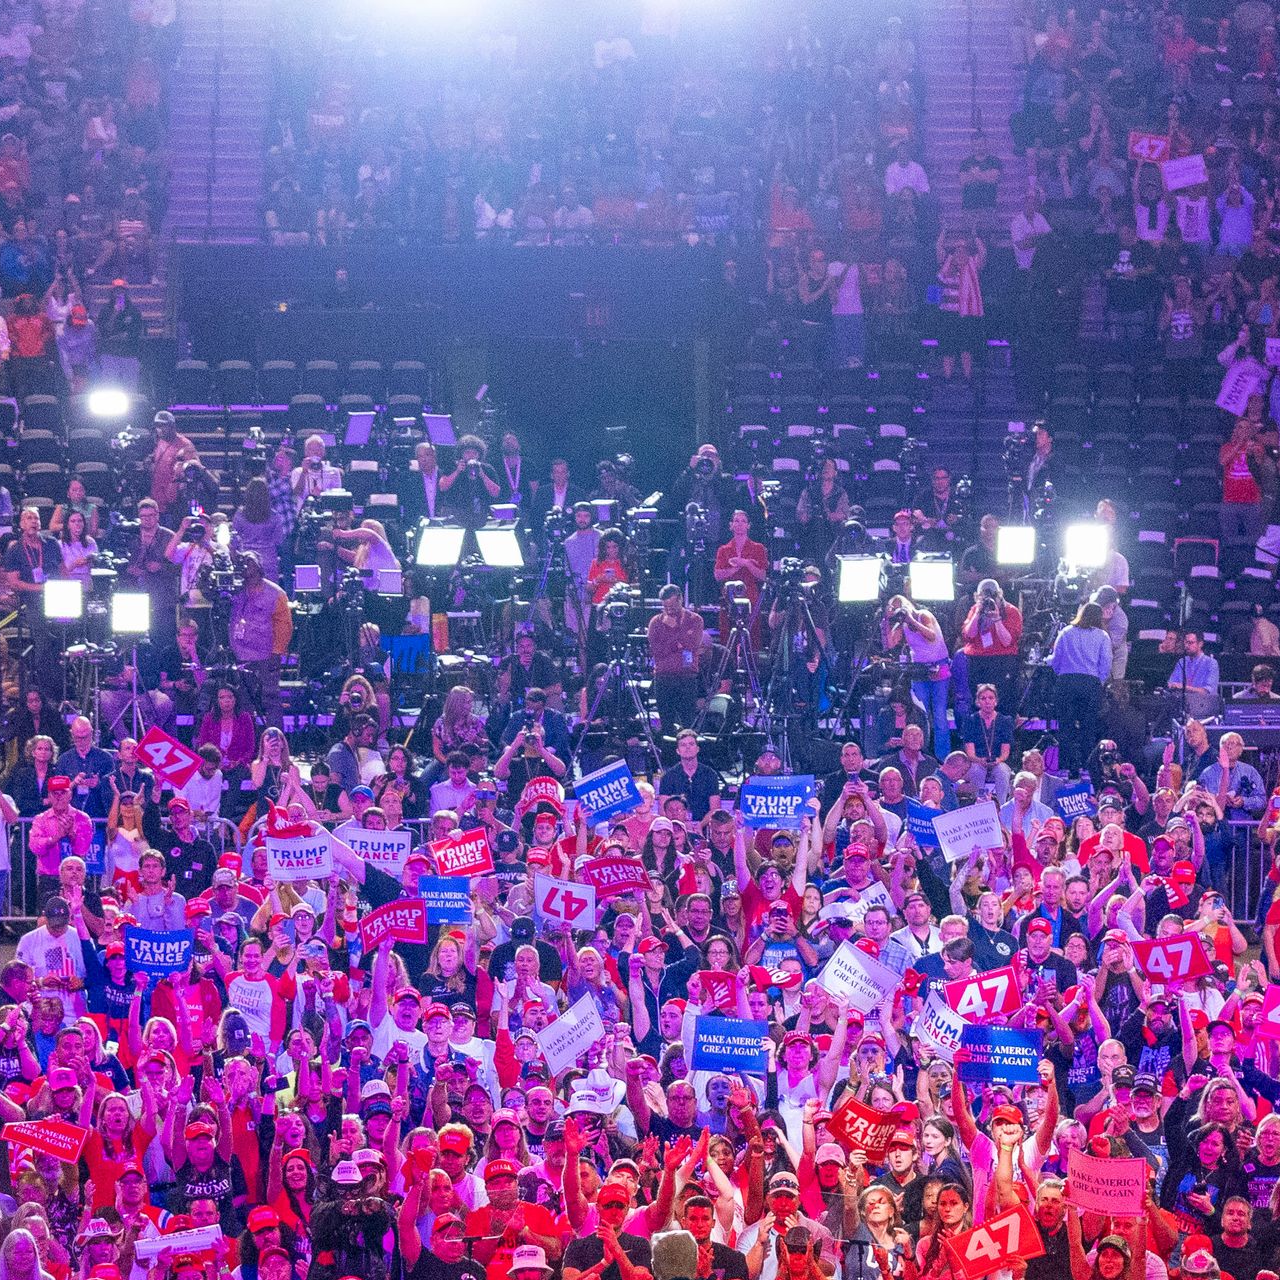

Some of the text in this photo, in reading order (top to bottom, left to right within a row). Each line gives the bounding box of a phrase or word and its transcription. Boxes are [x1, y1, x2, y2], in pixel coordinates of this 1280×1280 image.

[1127, 138, 1166, 158] 47
[144, 741, 194, 774] 47
[581, 776, 630, 806] TRUMP
[589, 787, 629, 810] VANCE
[745, 794, 802, 806] TRUMP
[750, 805, 796, 815] VANCE
[941, 817, 996, 839] MAKE AMERICA
[271, 846, 327, 860] TRUMP
[349, 839, 406, 852] TRUMP
[437, 839, 486, 863] TRUMP
[277, 857, 323, 867] VANCE
[444, 852, 483, 868] VANCE
[590, 863, 644, 880] TRUMP
[600, 872, 641, 885] VANCE
[421, 891, 439, 899] MAKE
[543, 887, 588, 921] 47
[364, 909, 422, 933] TRUMP
[371, 919, 416, 938] VANCE
[128, 938, 191, 953] TRUMP
[135, 951, 184, 963] VANCE
[1147, 940, 1193, 978] 47
[833, 969, 859, 988] GREAT
[834, 957, 887, 994] MAKE AMERICA
[235, 986, 264, 998] FIGHT
[956, 974, 1009, 1018] 47
[233, 996, 261, 1008] FIGHT
[564, 1010, 596, 1036] AMERICA
[699, 1034, 725, 1044] MAKE
[923, 1015, 959, 1050] VANCE
[702, 1045, 759, 1056] GREAT AGAIN
[966, 1043, 1038, 1056] MAKE AMERICA
[969, 1054, 1032, 1066] GREAT AGAIN
[843, 1109, 895, 1138] TRUMP
[13, 1126, 73, 1150] GREAT AGAIN
[39, 1129, 79, 1145] AMERICA
[845, 1125, 888, 1148] VANCE
[1070, 1167, 1140, 1188] MAKE AMERICA
[185, 1179, 230, 1196] TRUMP
[1072, 1181, 1135, 1198] GREAT AGAIN
[965, 1212, 1021, 1261] 47
